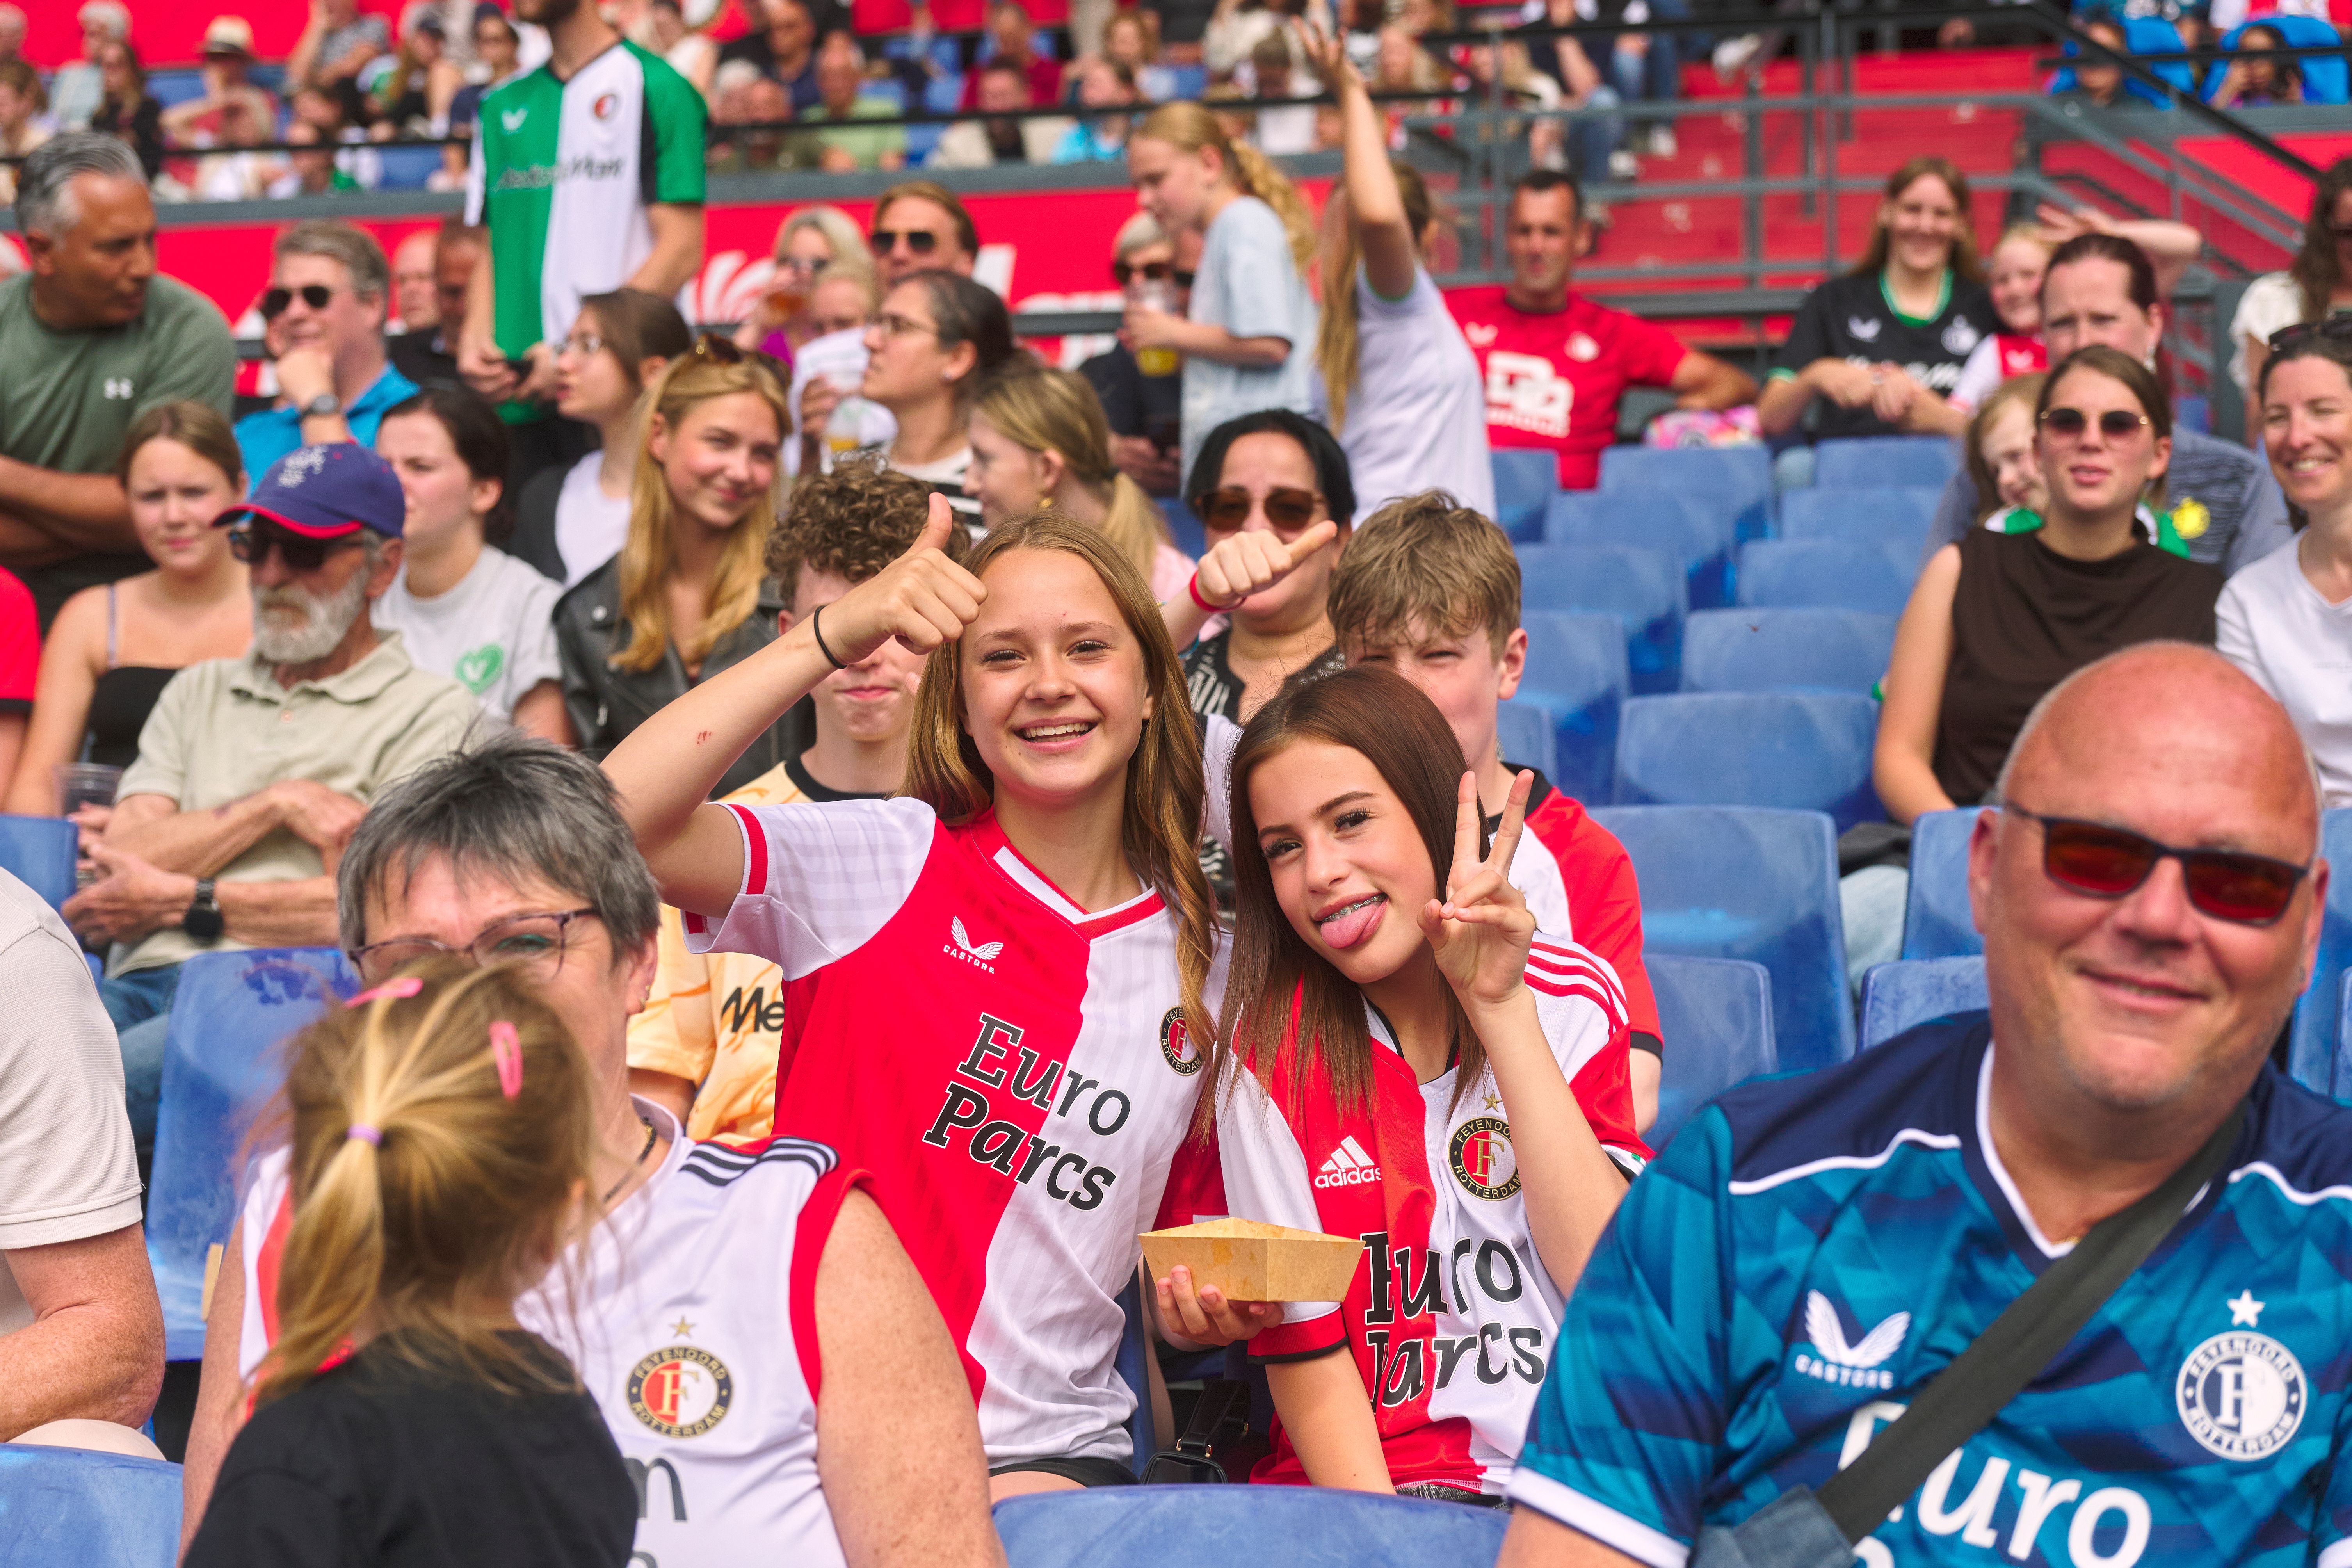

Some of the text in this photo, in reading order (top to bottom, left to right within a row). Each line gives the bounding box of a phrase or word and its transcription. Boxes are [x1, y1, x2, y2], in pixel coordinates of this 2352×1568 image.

[943, 945, 995, 974] CASTORE
[1162, 1038, 1201, 1072] ROTTERDAM
[956, 1012, 1131, 1136] Euro
[922, 1081, 1117, 1212] Parcs
[1456, 1119, 1512, 1143] FEYENOO
[1315, 1167, 1381, 1188] adidas
[635, 1348, 727, 1379] FEYENOORD
[1795, 1354, 1893, 1390] CASTORE
[2188, 1338, 2295, 1382] FEYENOORD
[632, 1402, 725, 1436] ROTTERDAM
